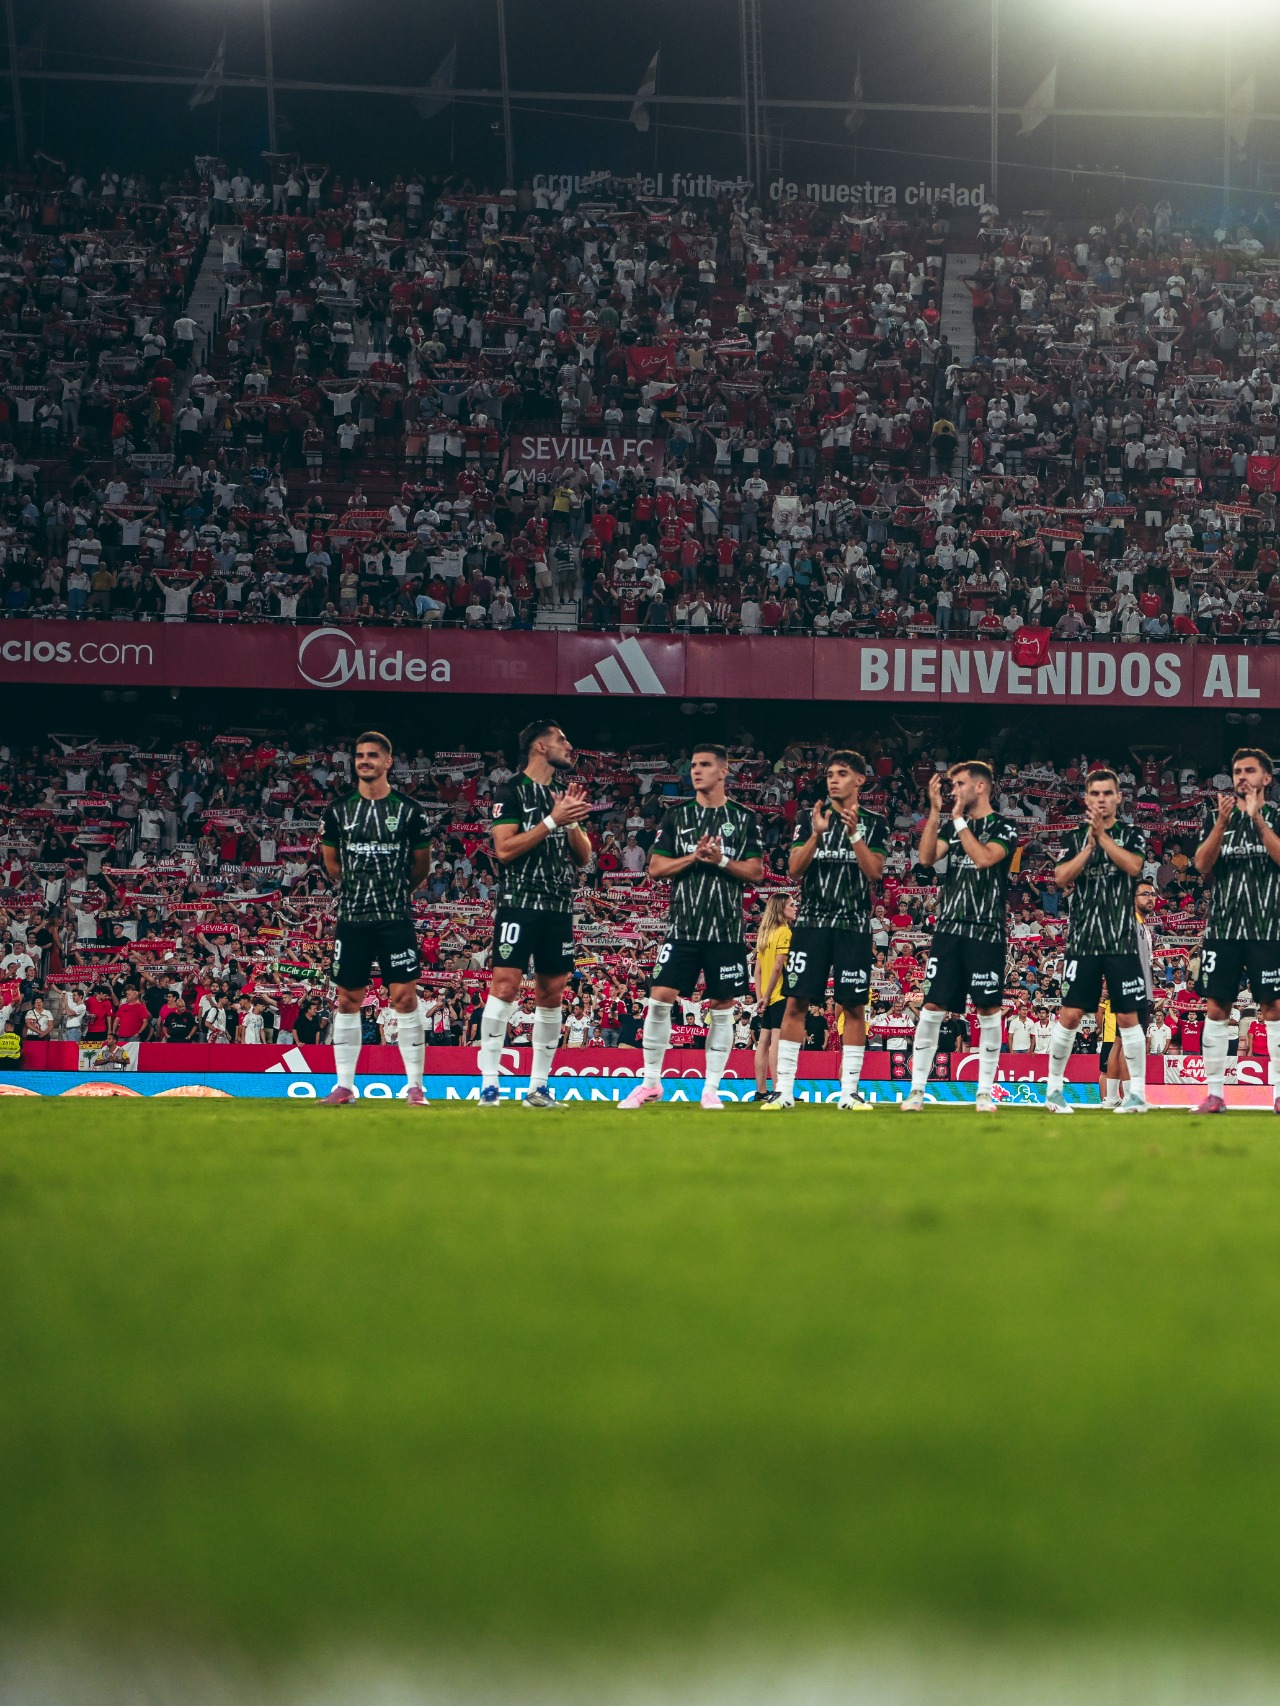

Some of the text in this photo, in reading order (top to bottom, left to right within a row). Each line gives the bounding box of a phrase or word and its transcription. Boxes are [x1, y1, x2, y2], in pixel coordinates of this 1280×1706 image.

[770, 178, 798, 201] de
[807, 181, 897, 204] nuestra
[904, 181, 985, 206] ciudad
[521, 437, 654, 462] SEVILLA FC
[0, 641, 154, 666] cios.com
[312, 640, 451, 685] Midea
[860, 648, 1182, 699] BIENVENIDOS
[1202, 655, 1261, 699] AL
[451, 823, 478, 831] SEVILLA
[201, 925, 238, 933] SEVILLA FC
[500, 922, 521, 944] 10
[333, 939, 342, 961] 9
[390, 951, 407, 961] Next
[786, 950, 807, 974] 35
[720, 965, 736, 973] Next
[841, 969, 858, 977] Next
[972, 973, 989, 981] Next
[1262, 971, 1277, 979] Next
[1122, 981, 1138, 990] Next
[676, 1025, 705, 1036] SEVILLA
[1166, 1058, 1205, 1069] TE AM
[1179, 1068, 1208, 1078] SEVI
